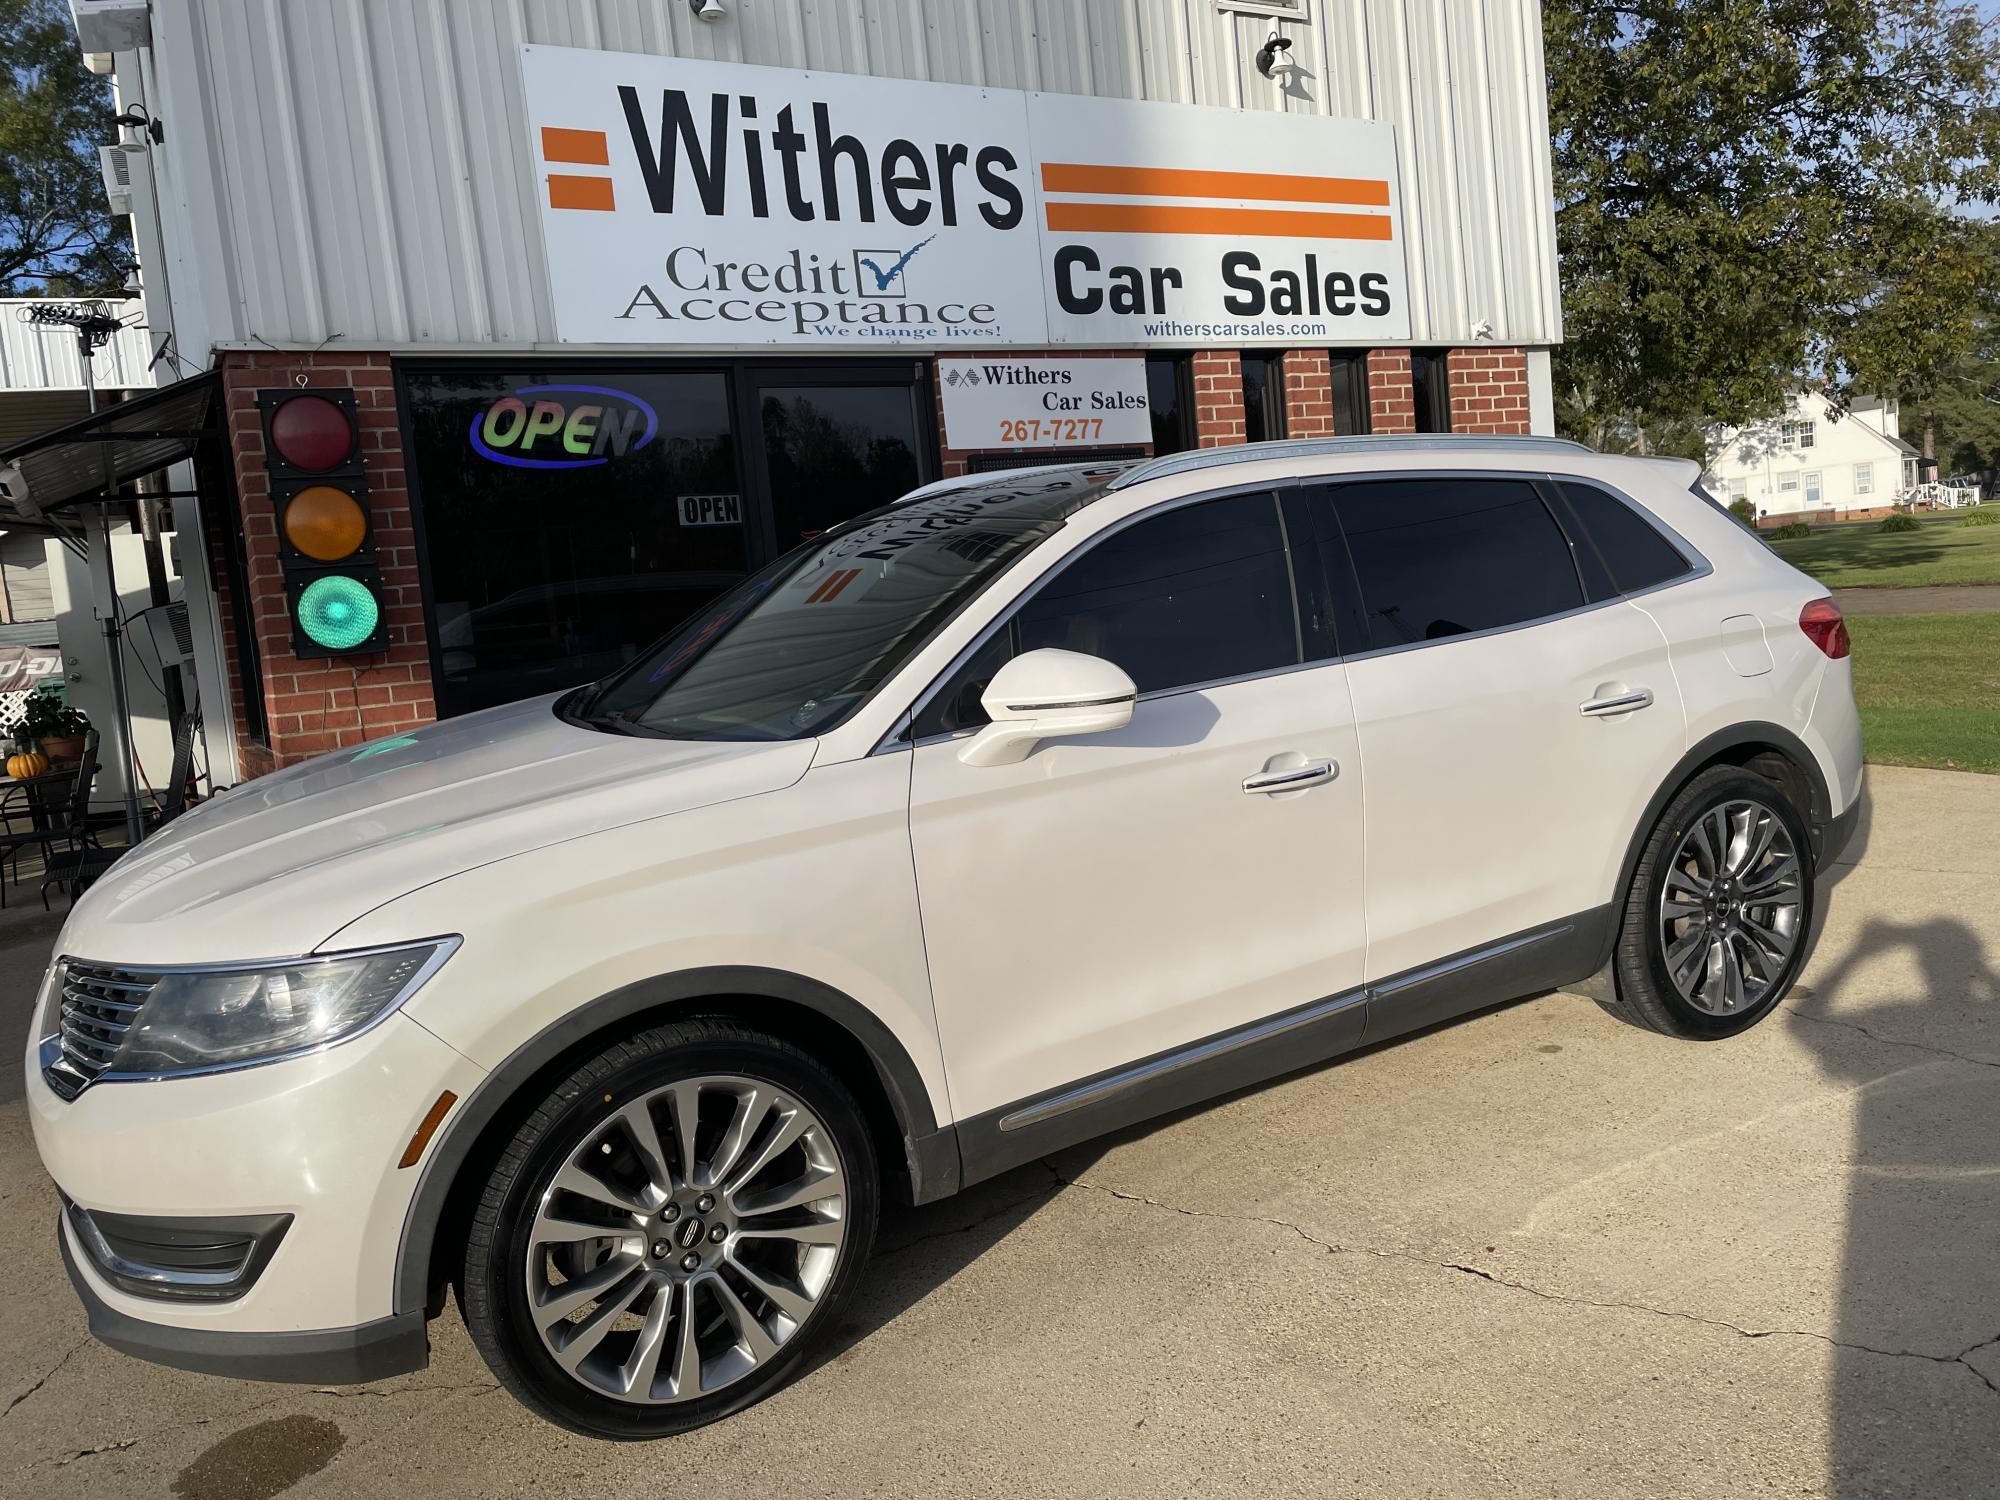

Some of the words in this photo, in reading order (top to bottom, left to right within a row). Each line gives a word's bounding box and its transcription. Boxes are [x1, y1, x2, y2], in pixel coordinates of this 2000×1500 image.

[616, 84, 1024, 230] Withers
[665, 246, 851, 294] Credit
[1053, 244, 1182, 316] Car
[1221, 250, 1391, 316] Sales
[613, 284, 996, 335] Acceptance
[813, 325, 850, 337] We
[857, 325, 938, 340] change
[946, 325, 1001, 337] lives!
[1143, 320, 1327, 337] witherscarsales.com
[982, 365, 1072, 385] Withers
[1042, 391, 1083, 411] Car
[1091, 391, 1147, 410] Sales
[482, 397, 639, 457] OPEN
[1000, 418, 1104, 442] 267-7277
[683, 496, 739, 523] OPEN
